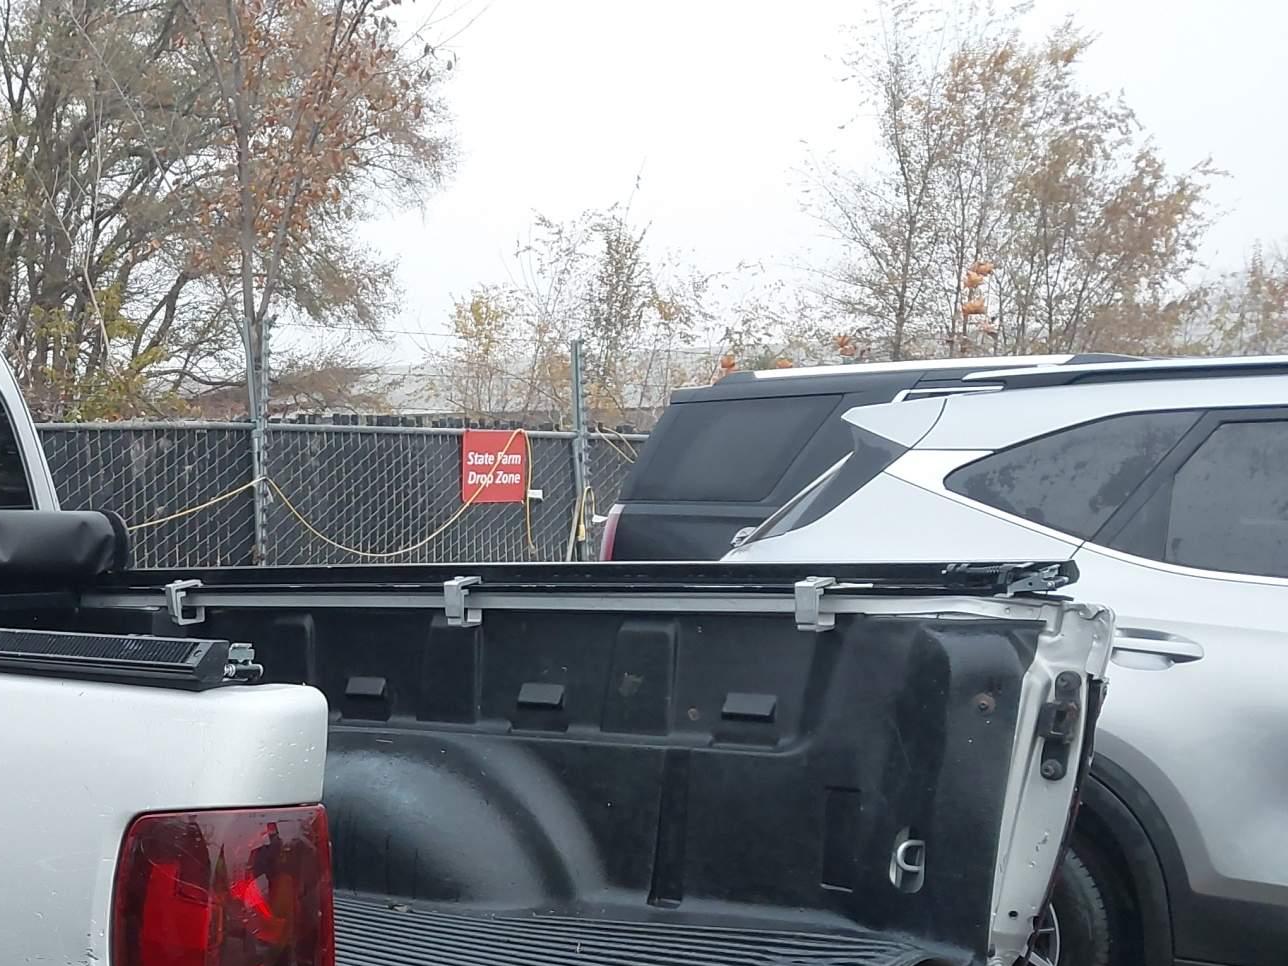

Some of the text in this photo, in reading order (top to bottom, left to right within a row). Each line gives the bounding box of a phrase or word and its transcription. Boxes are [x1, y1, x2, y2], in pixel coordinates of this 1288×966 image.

[467, 451, 521, 465] State Farm
[468, 471, 520, 487] Drop Zone
